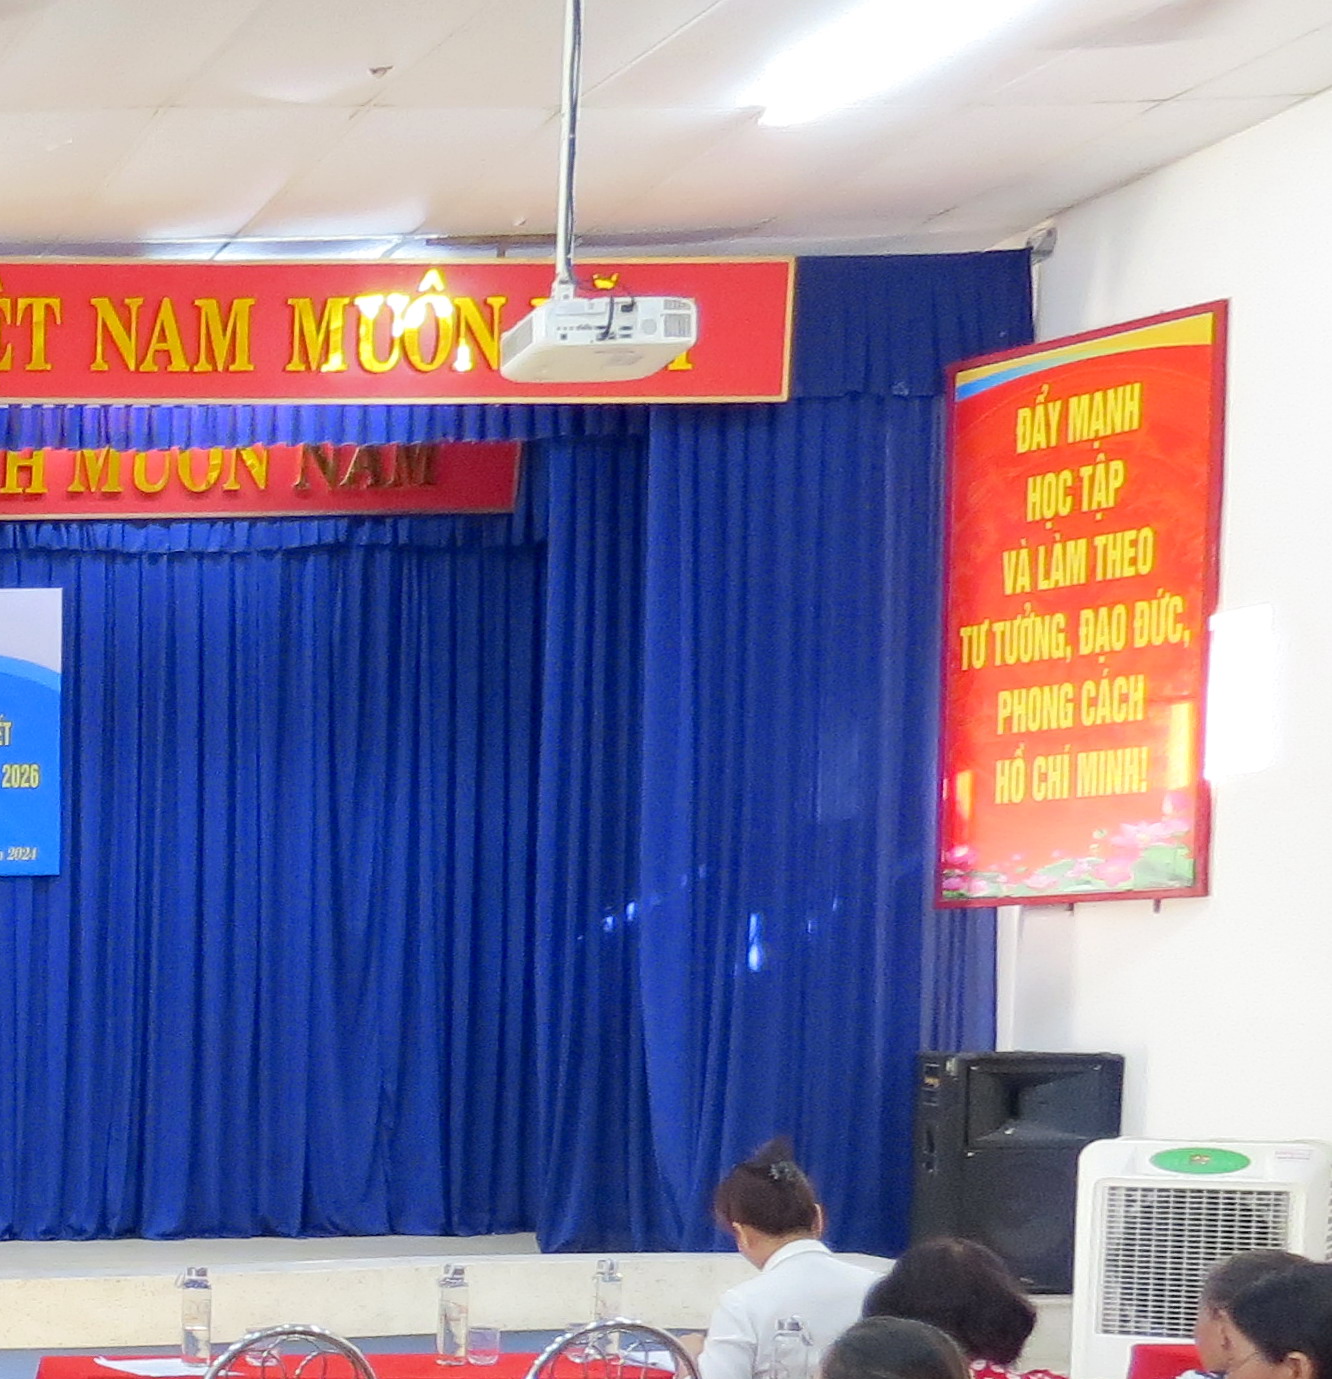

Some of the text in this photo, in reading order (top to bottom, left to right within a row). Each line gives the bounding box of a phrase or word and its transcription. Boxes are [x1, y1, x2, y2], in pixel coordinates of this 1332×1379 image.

[89, 297, 257, 373] NAM
[286, 268, 505, 374] MUÔN
[1015, 382, 1143, 454] ĐẨY MẠNH
[1026, 454, 1127, 534] HỌC TẬP
[1002, 527, 1154, 596] VÀ LÀM THEO
[960, 587, 1191, 671] TƯ TƯỞNG, ĐẠO ĐỨC,
[996, 667, 1145, 736] PHONG CÁCH
[1, 763, 41, 789] 2026
[994, 740, 1148, 805] HỒ CHÍ MINH!
